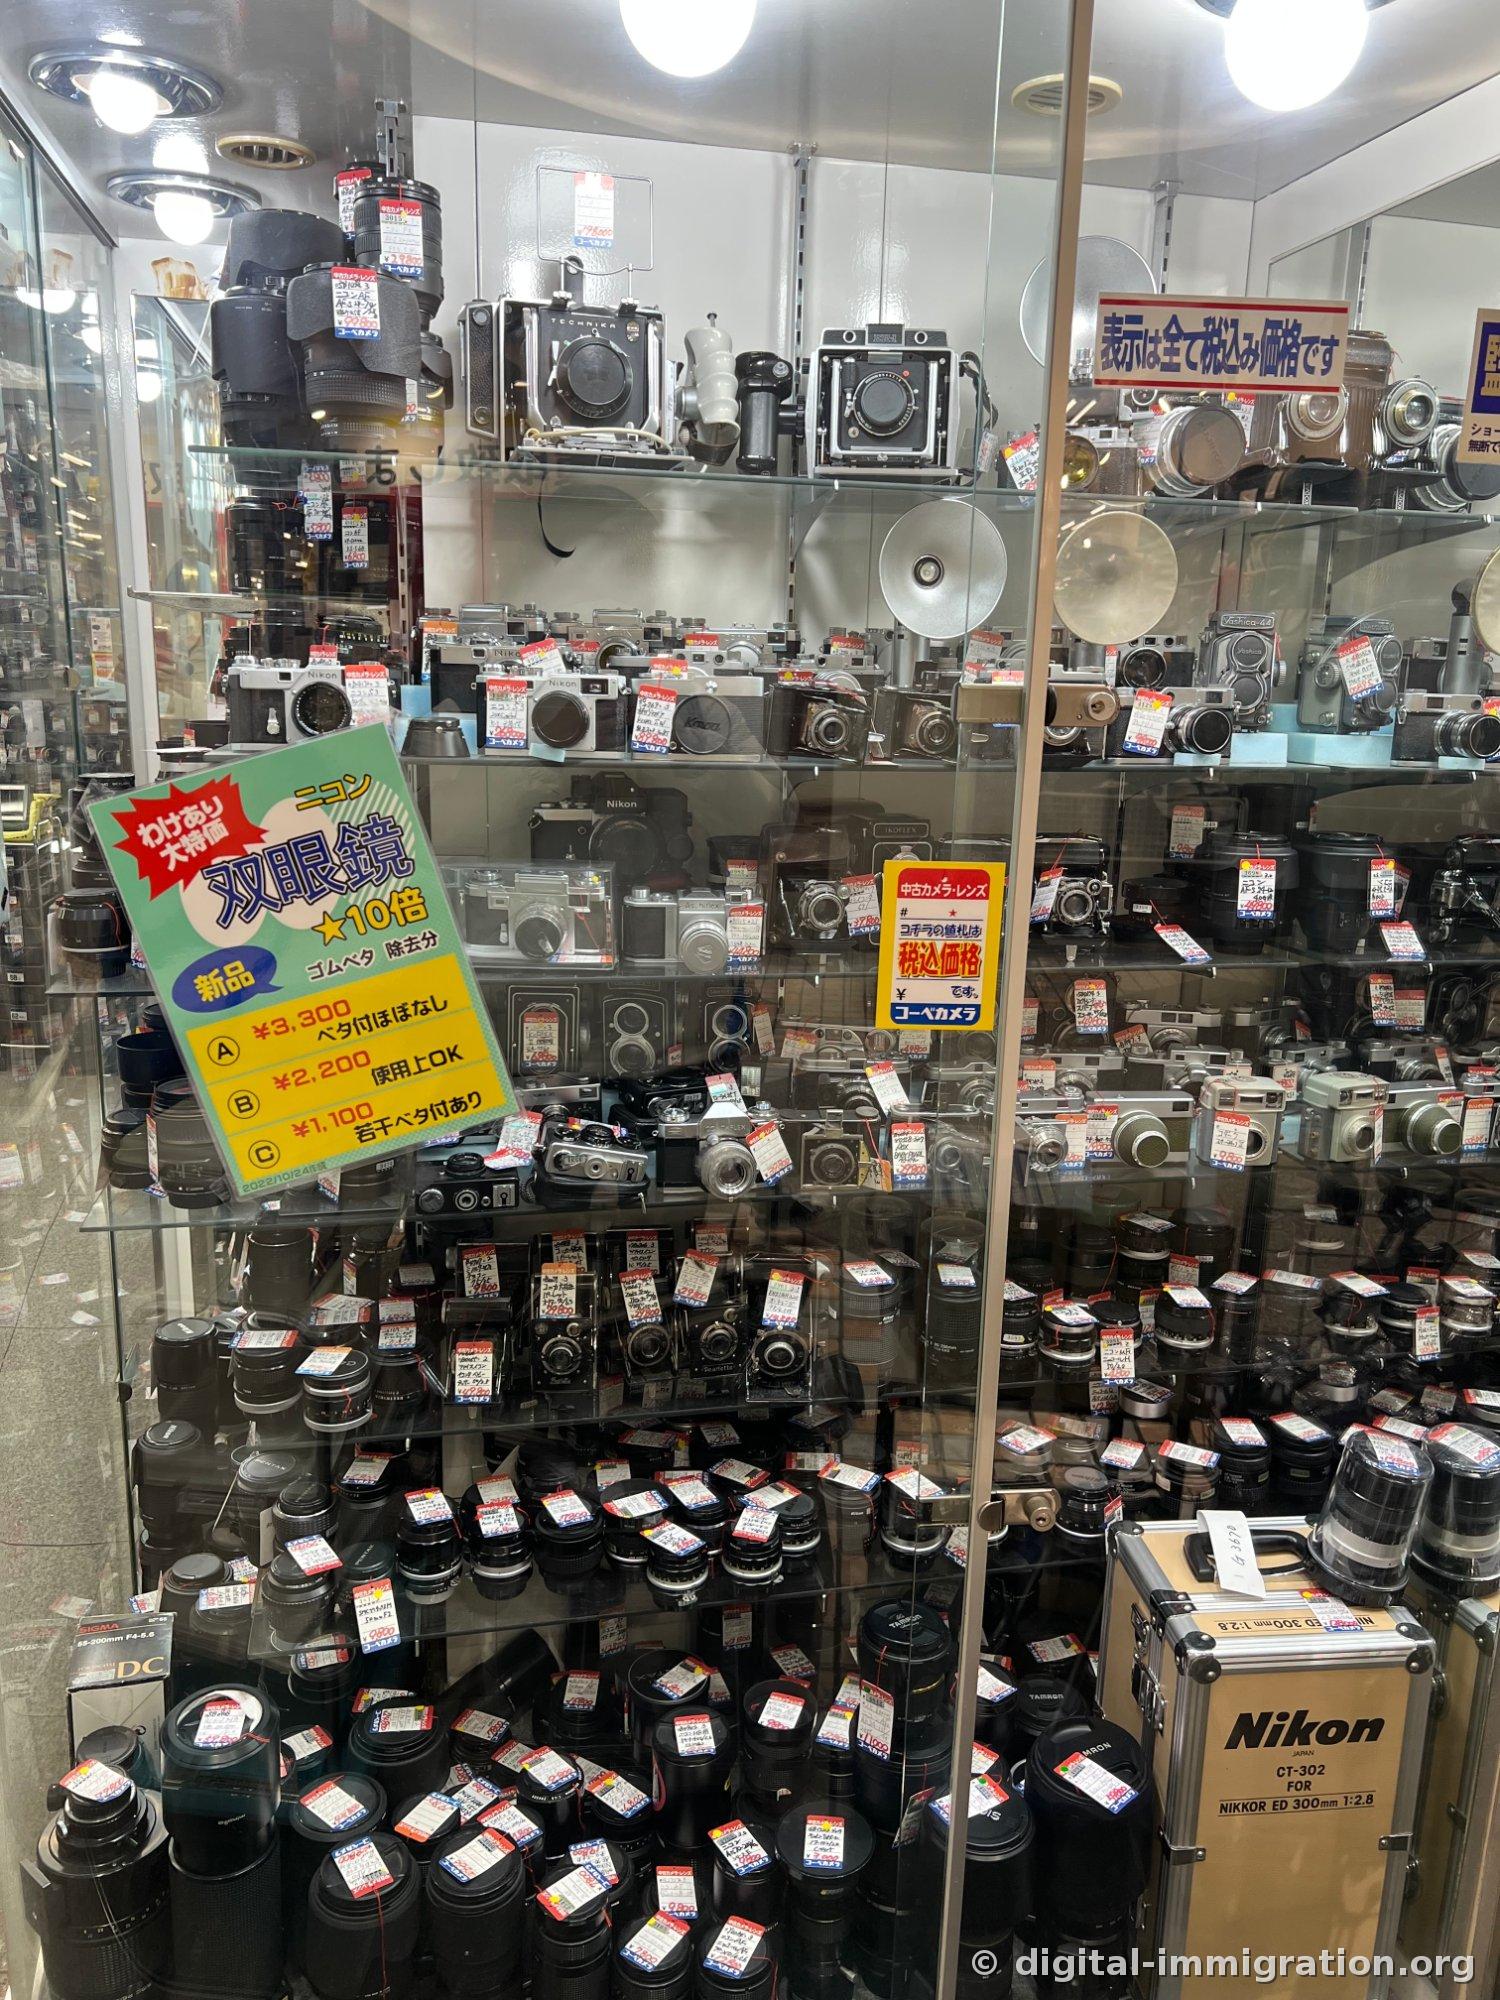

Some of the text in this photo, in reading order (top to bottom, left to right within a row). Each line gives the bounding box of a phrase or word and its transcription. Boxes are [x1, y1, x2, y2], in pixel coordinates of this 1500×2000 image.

[333, 271, 376, 282] 中古カメラ・レンズ
[384, 264, 423, 275] コーベカメラ
[551, 317, 617, 329] TECHNIKA
[337, 328, 379, 338] コーベカメラ
[1100, 311, 1341, 379] 表示は全て税込み価格です
[1223, 614, 1273, 627] Yashica-44
[308, 670, 337, 680] Nikon
[549, 679, 577, 688] Nikon
[488, 738, 525, 748] コーベカメラ
[632, 741, 668, 754] コーベカメラ
[1125, 743, 1158, 755] コーベカメラ
[295, 772, 372, 813] ニコン
[605, 799, 638, 809] Nikon
[136, 794, 225, 847] わけあり
[159, 820, 231, 872] 大特価
[202, 812, 415, 930] 双眼鏡
[900, 882, 989, 898] 中古カメラ・レンズ
[900, 908, 908, 917] #
[1239, 910, 1272, 918] コーベカメラ
[900, 923, 982, 938] コチラの値札は
[306, 931, 440, 982] ゴムベタ 除去分
[727, 955, 761, 964] コーベカメラ
[898, 940, 982, 979] 税込価格
[193, 960, 256, 1002] 新品
[896, 984, 979, 1001] ¥ です。
[251, 999, 352, 1042] ¥3,300
[316, 994, 449, 1044] ベタ付ほぼなし
[894, 1006, 977, 1021] コーベカメラ
[1077, 1025, 1107, 1034] コーベカメラ
[271, 1049, 372, 1093] ¥2,200
[371, 1043, 465, 1088] 使用上OK
[290, 1102, 374, 1139] ¥1,100
[354, 1090, 483, 1144] 若干ベタ付あり
[1211, 1160, 1245, 1171] コーベカメラ
[896, 1173, 927, 1181] コーベカメラ
[1104, 1378, 1134, 1386] コーベカメラ
[457, 1395, 491, 1403] コーベカメラ
[79, 1622, 120, 1634] SIGMA
[1217, 1621, 1252, 1632] 1:2.8
[1254, 1619, 1302, 1631] 300mm
[363, 1635, 399, 1652] コーベカメラ
[117, 1655, 165, 1679] DC
[1029, 1692, 1065, 1701] TAMRON
[1224, 1709, 1386, 1750] Nikon
[857, 1740, 889, 1760] コーベカメラ
[1082, 1741, 1113, 1757] MRON
[1276, 1764, 1326, 1779] CT-302
[1287, 1781, 1312, 1792] FOR
[1219, 1793, 1374, 1815] NIKKOR ED 300mm 1:2.8
[803, 1860, 842, 1869] コーベカメラ
